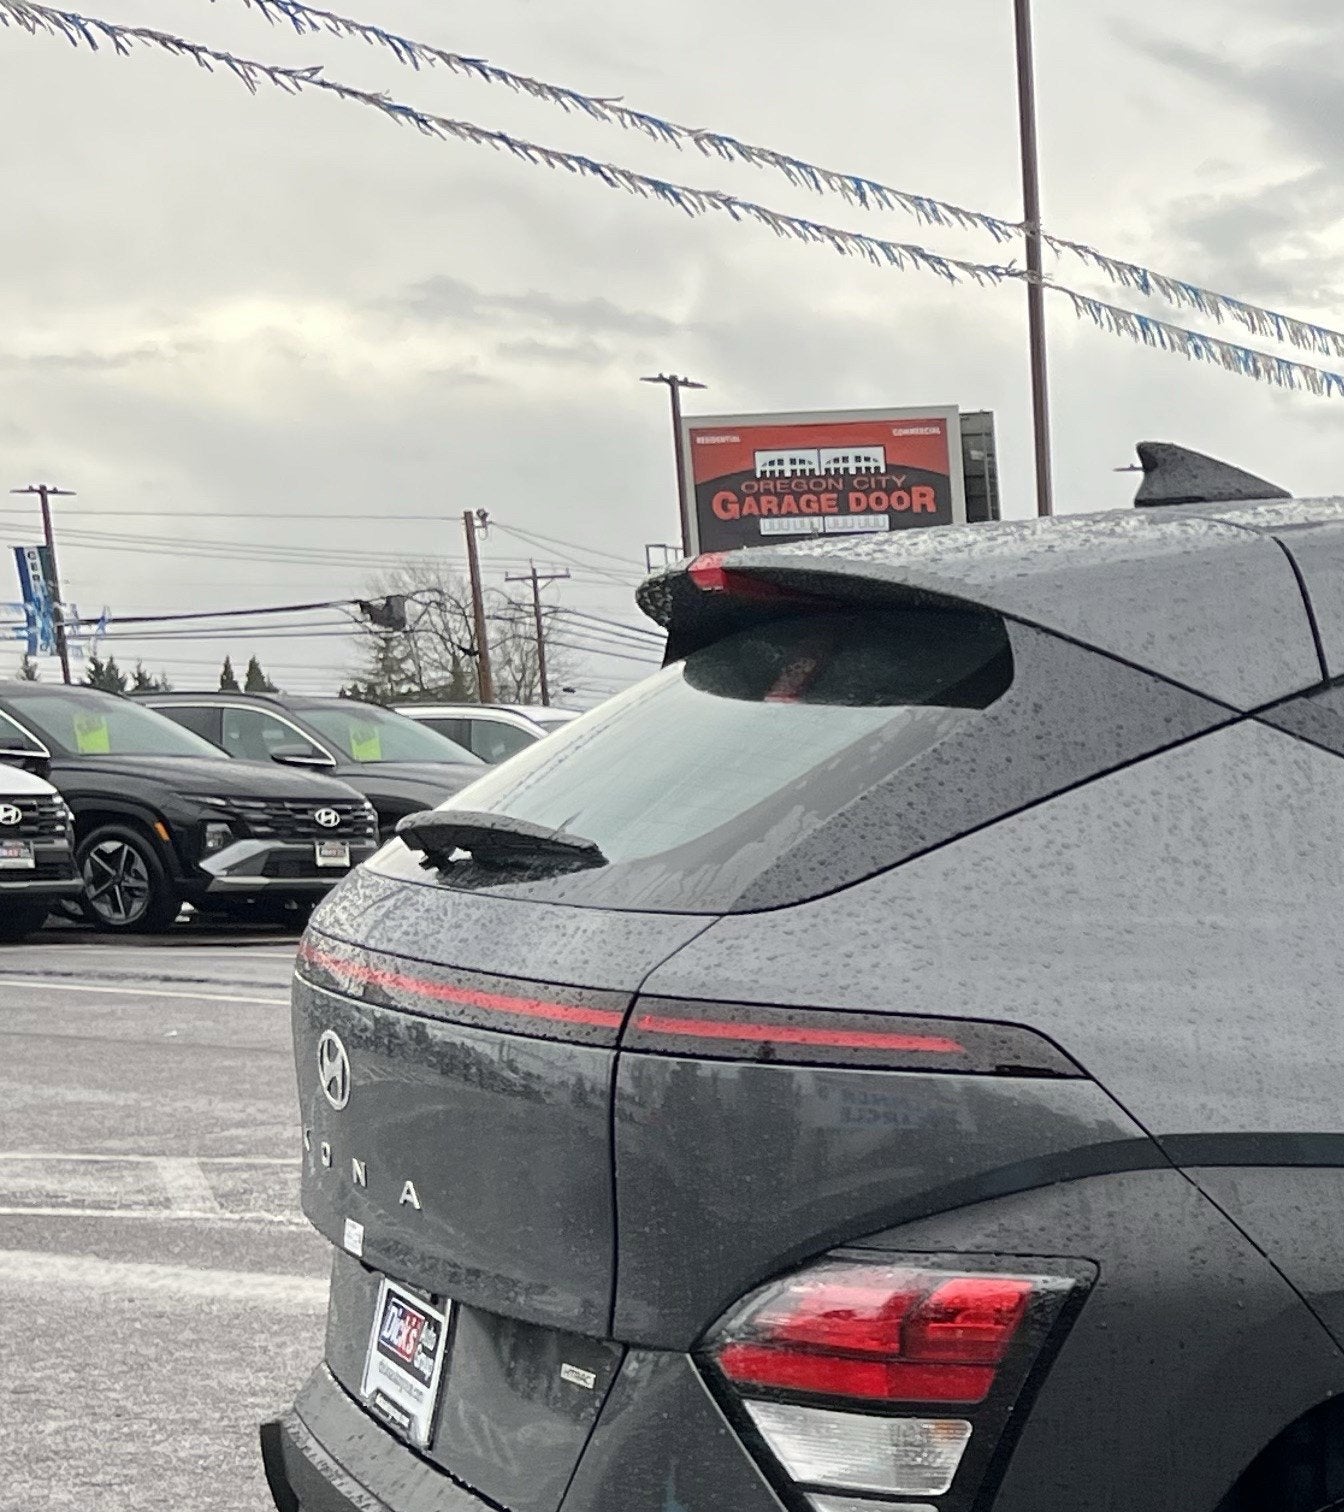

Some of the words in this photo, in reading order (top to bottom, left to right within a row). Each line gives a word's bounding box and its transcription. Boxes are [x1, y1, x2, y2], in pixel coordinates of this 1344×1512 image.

[741, 478, 843, 493] OREGON
[854, 475, 907, 490] CITY
[712, 491, 838, 520] GARAGE
[850, 486, 936, 513] DOOR
